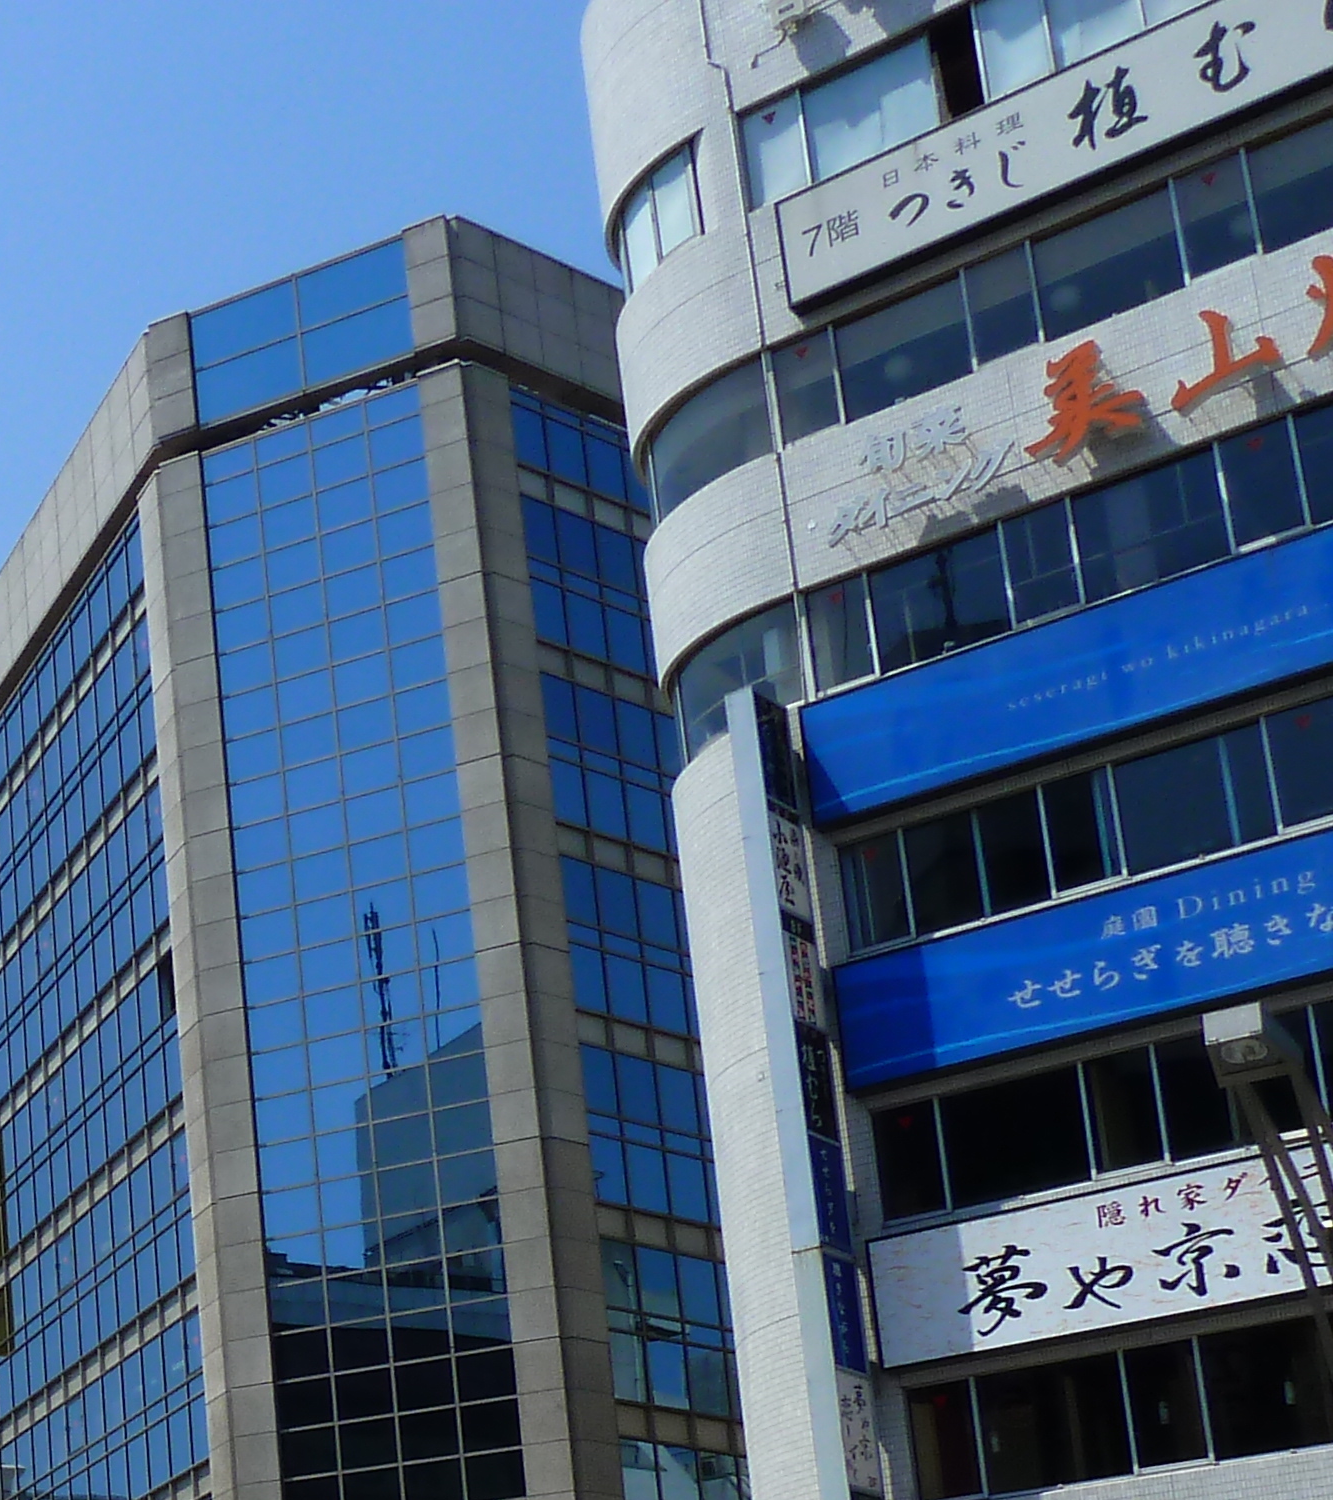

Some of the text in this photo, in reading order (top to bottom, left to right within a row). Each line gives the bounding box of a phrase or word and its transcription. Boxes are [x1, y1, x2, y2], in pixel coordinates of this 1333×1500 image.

[882, 112, 1024, 188] 日本料理
[889, 140, 1027, 226] つきじ
[801, 208, 860, 258] 7階
[830, 437, 1015, 547] ダイニング
[1121, 654, 1155, 676] wo
[1175, 868, 1317, 922] Dining
